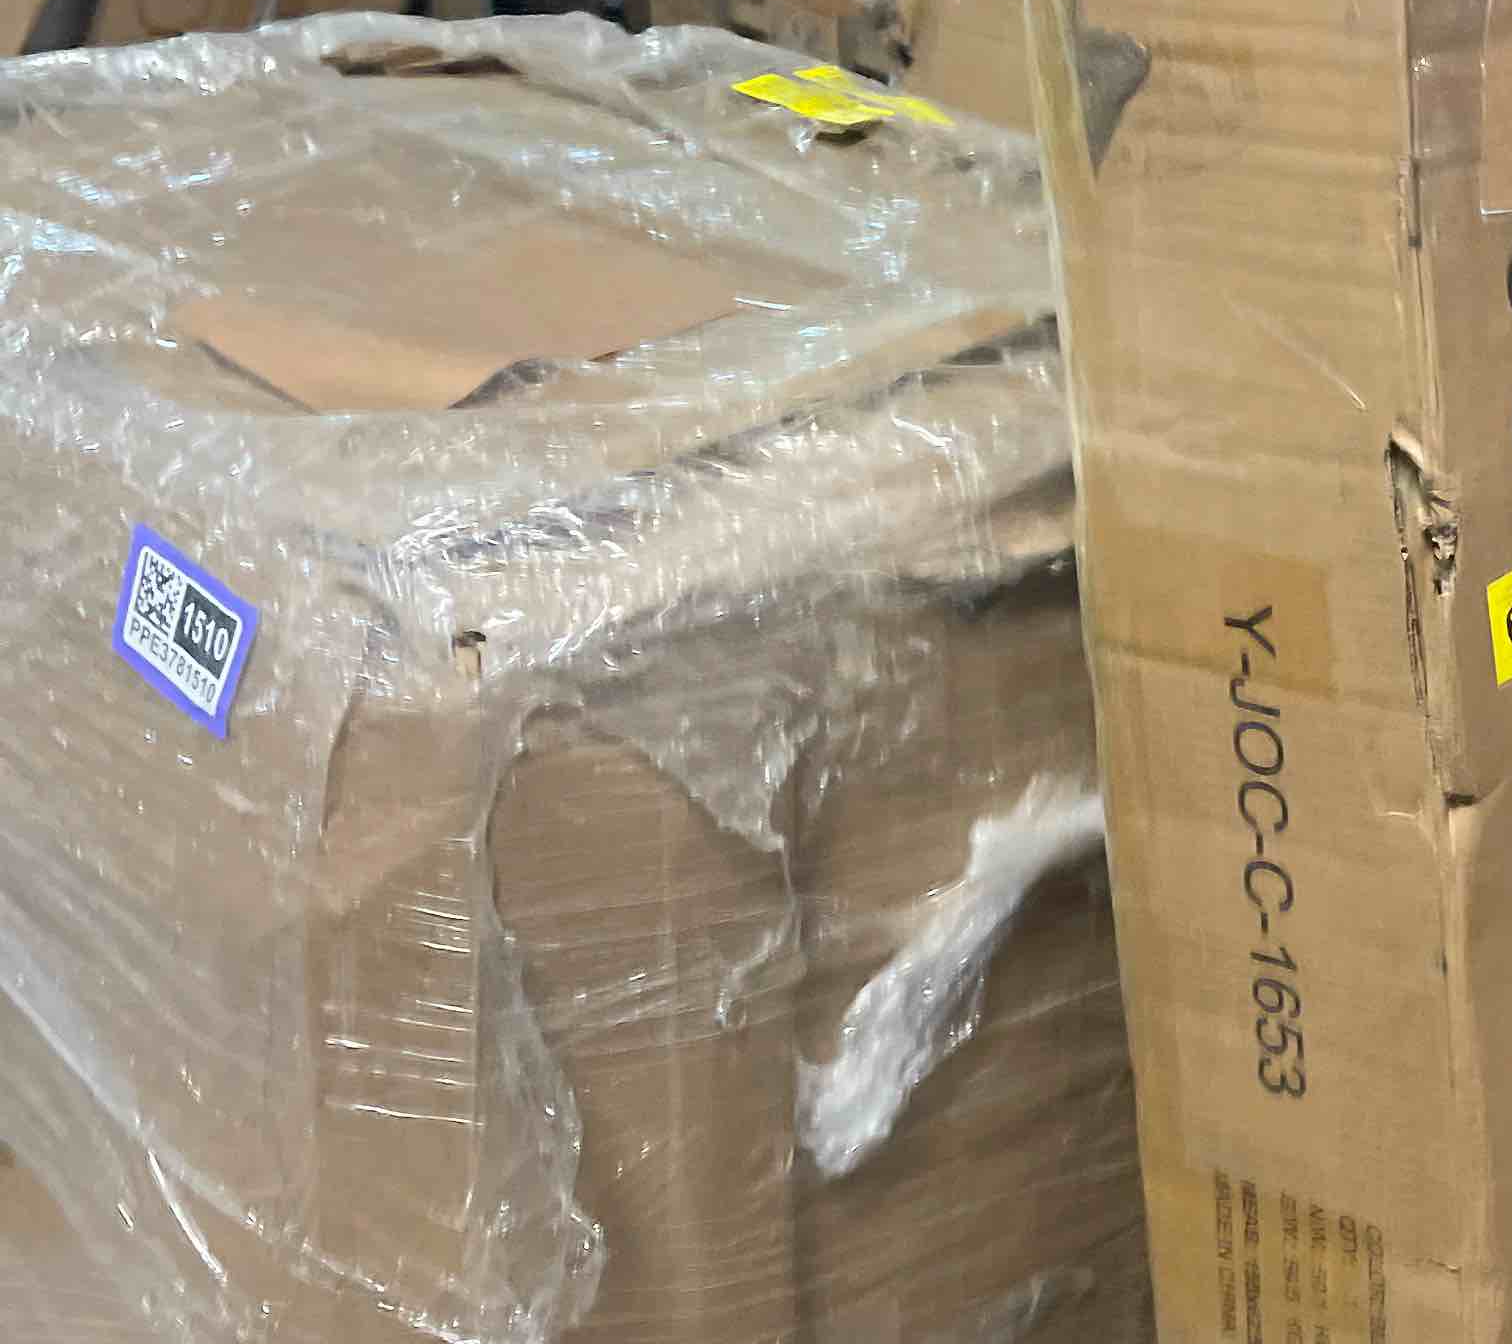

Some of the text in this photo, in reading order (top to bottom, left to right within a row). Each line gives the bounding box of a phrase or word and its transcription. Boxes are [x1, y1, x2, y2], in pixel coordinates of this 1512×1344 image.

[130, 618, 216, 703] PPE3781510
[183, 602, 229, 661] 1510
[1224, 604, 1307, 1099] Y-JOC-C-1653
